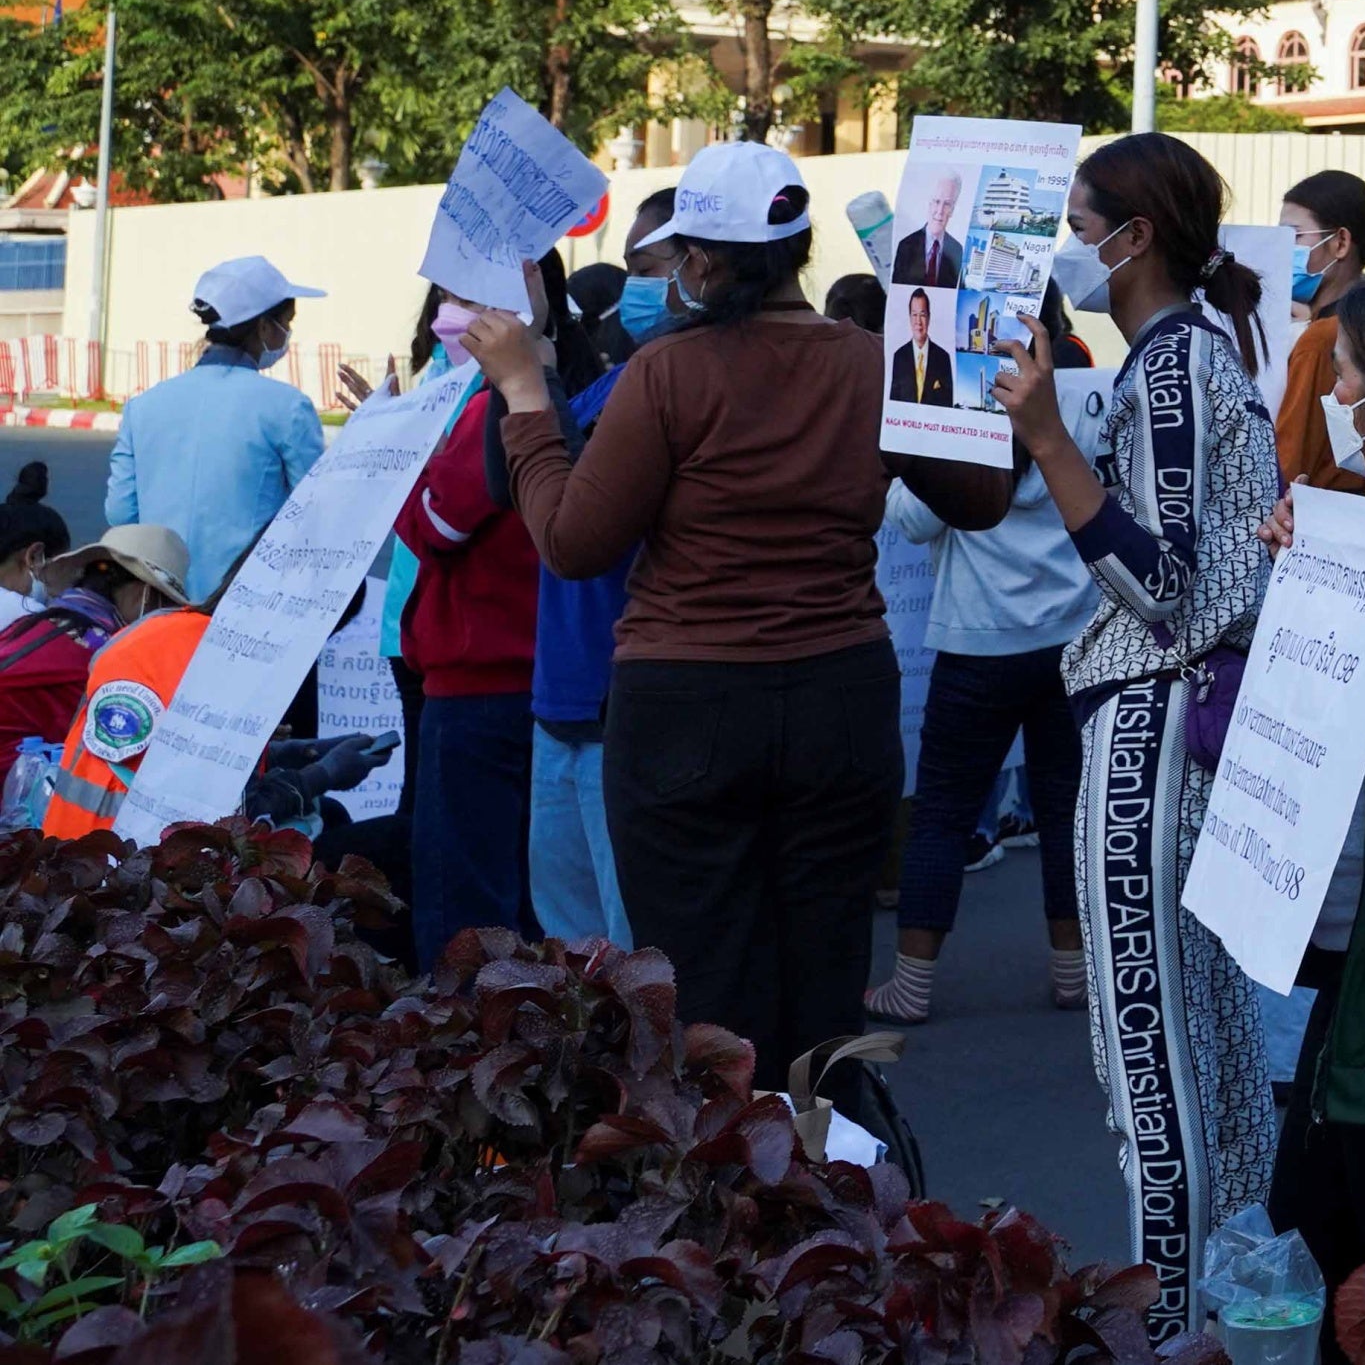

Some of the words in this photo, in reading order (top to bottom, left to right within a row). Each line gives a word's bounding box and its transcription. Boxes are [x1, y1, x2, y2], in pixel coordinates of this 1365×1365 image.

[1037, 175, 1045, 184] In
[1047, 175, 1067, 186] 1995
[680, 190, 723, 213] STRIKE
[1022, 241, 1051, 255] Naga1
[1000, 363, 1020, 375] Naga
[885, 417, 901, 427] NAGA
[902, 419, 922, 430] WORLD
[923, 421, 940, 432] MUST
[941, 424, 978, 437] REINSTATED
[1157, 467, 1192, 534] Dior
[1331, 652, 1360, 684] C98
[1110, 677, 1164, 795] ristian
[1294, 733, 1328, 769] ensure
[1105, 797, 1150, 869] Dior
[1274, 858, 1305, 901] C98
[1108, 874, 1158, 996] PARIS
[1117, 1003, 1173, 1157] Christian
[1142, 1159, 1182, 1229] Dior
